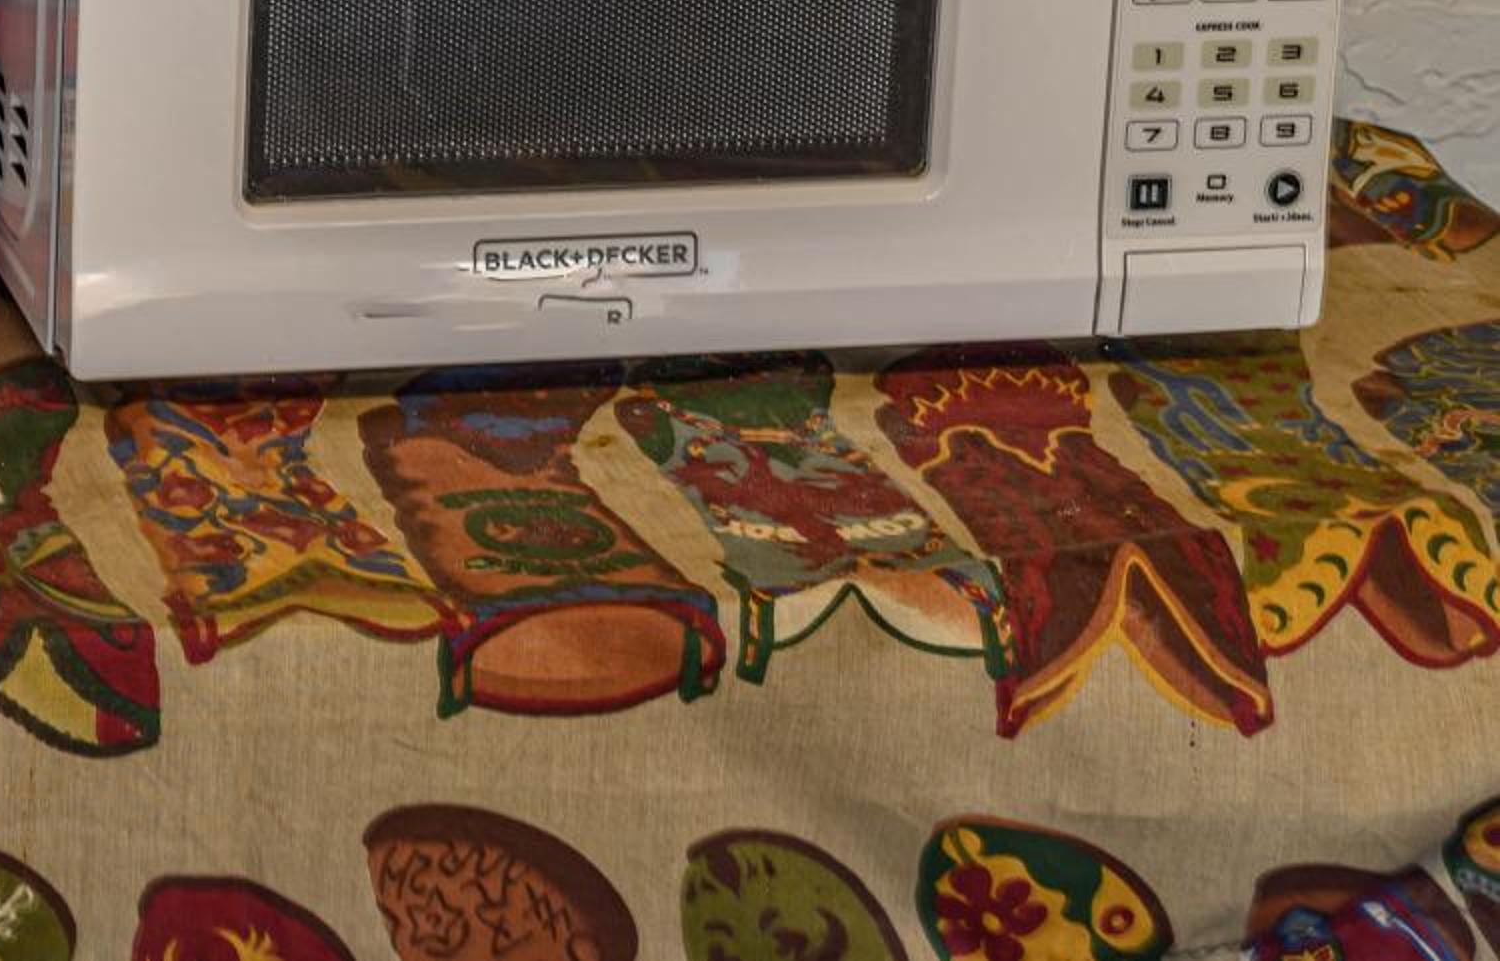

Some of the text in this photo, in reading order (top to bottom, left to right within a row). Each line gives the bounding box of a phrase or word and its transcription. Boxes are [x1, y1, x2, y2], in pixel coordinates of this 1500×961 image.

[1154, 48, 1162, 65] 1
[1215, 46, 1237, 62] 2
[1281, 44, 1302, 60] 3
[1145, 87, 1165, 103] 4
[1213, 85, 1233, 101] 5
[1279, 83, 1299, 99] 6
[1142, 127, 1162, 143] 7
[1210, 125, 1231, 141] 8
[1275, 122, 1296, 138] 9
